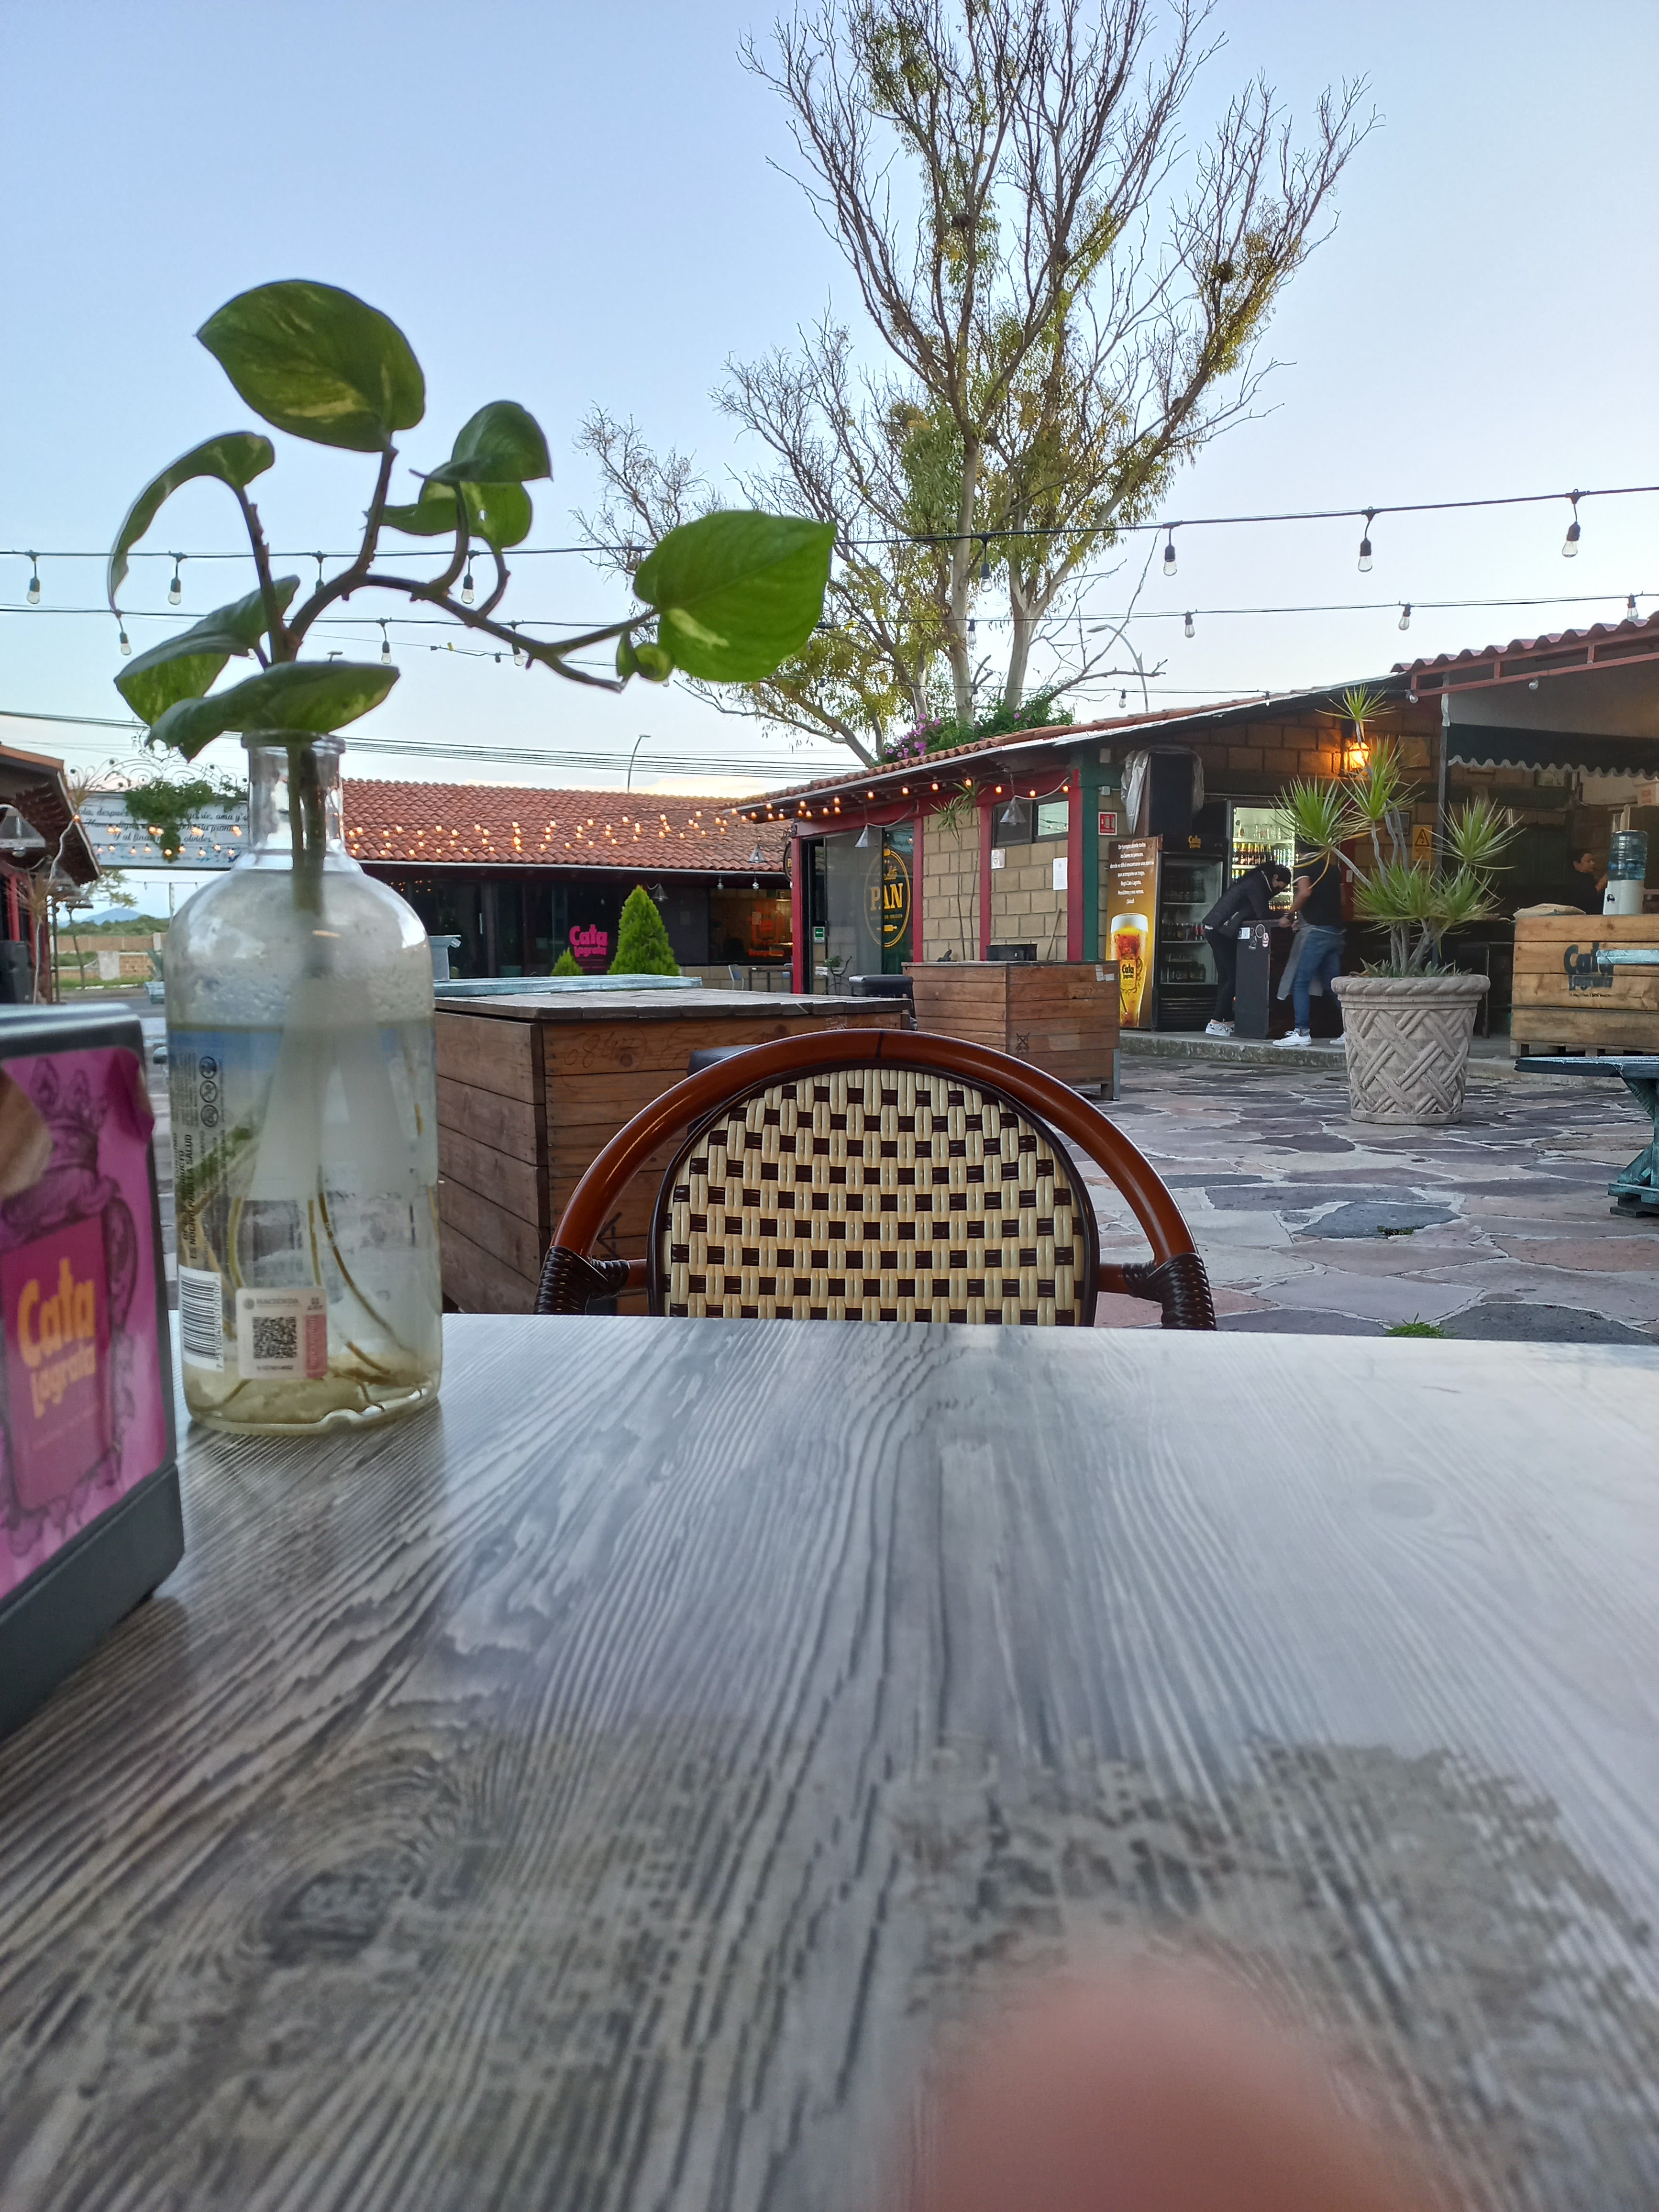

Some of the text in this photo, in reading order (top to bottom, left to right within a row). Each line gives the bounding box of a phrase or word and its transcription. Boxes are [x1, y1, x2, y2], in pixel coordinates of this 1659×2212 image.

[870, 883, 904, 911] PAN
[569, 924, 608, 946] Cata
[1122, 962, 1135, 974] Cata
[184, 1134, 193, 1165] SALUD
[18, 1257, 95, 1368] Cata
